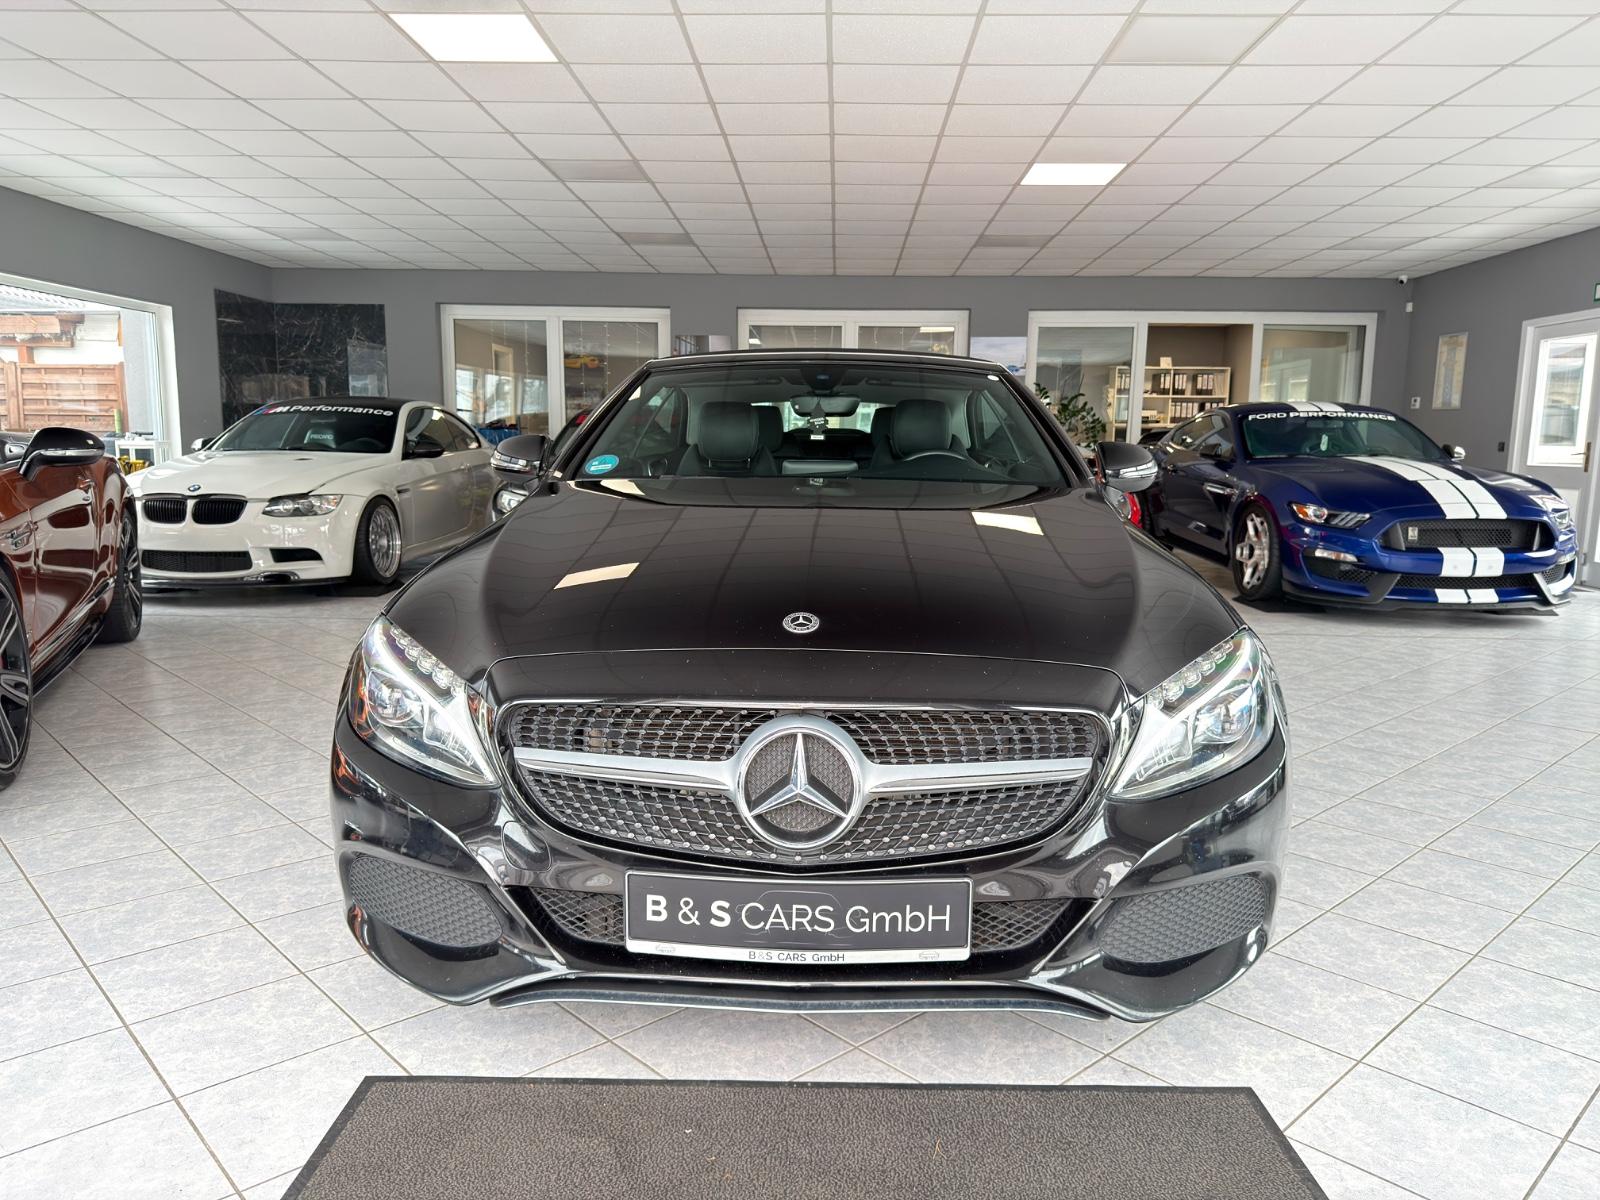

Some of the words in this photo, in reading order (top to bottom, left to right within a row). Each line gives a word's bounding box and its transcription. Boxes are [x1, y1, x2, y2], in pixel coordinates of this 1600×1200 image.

[290, 404, 394, 417] Performance
[1248, 411, 1287, 421] FORD
[1289, 411, 1397, 422] PERFORMANCE
[646, 894, 668, 923] B
[677, 897, 700, 926] &
[710, 900, 731, 928] S
[741, 901, 835, 933] CARS
[845, 904, 950, 934] GmbH
[777, 952, 807, 962] CARS
[812, 953, 845, 962] GmbH
